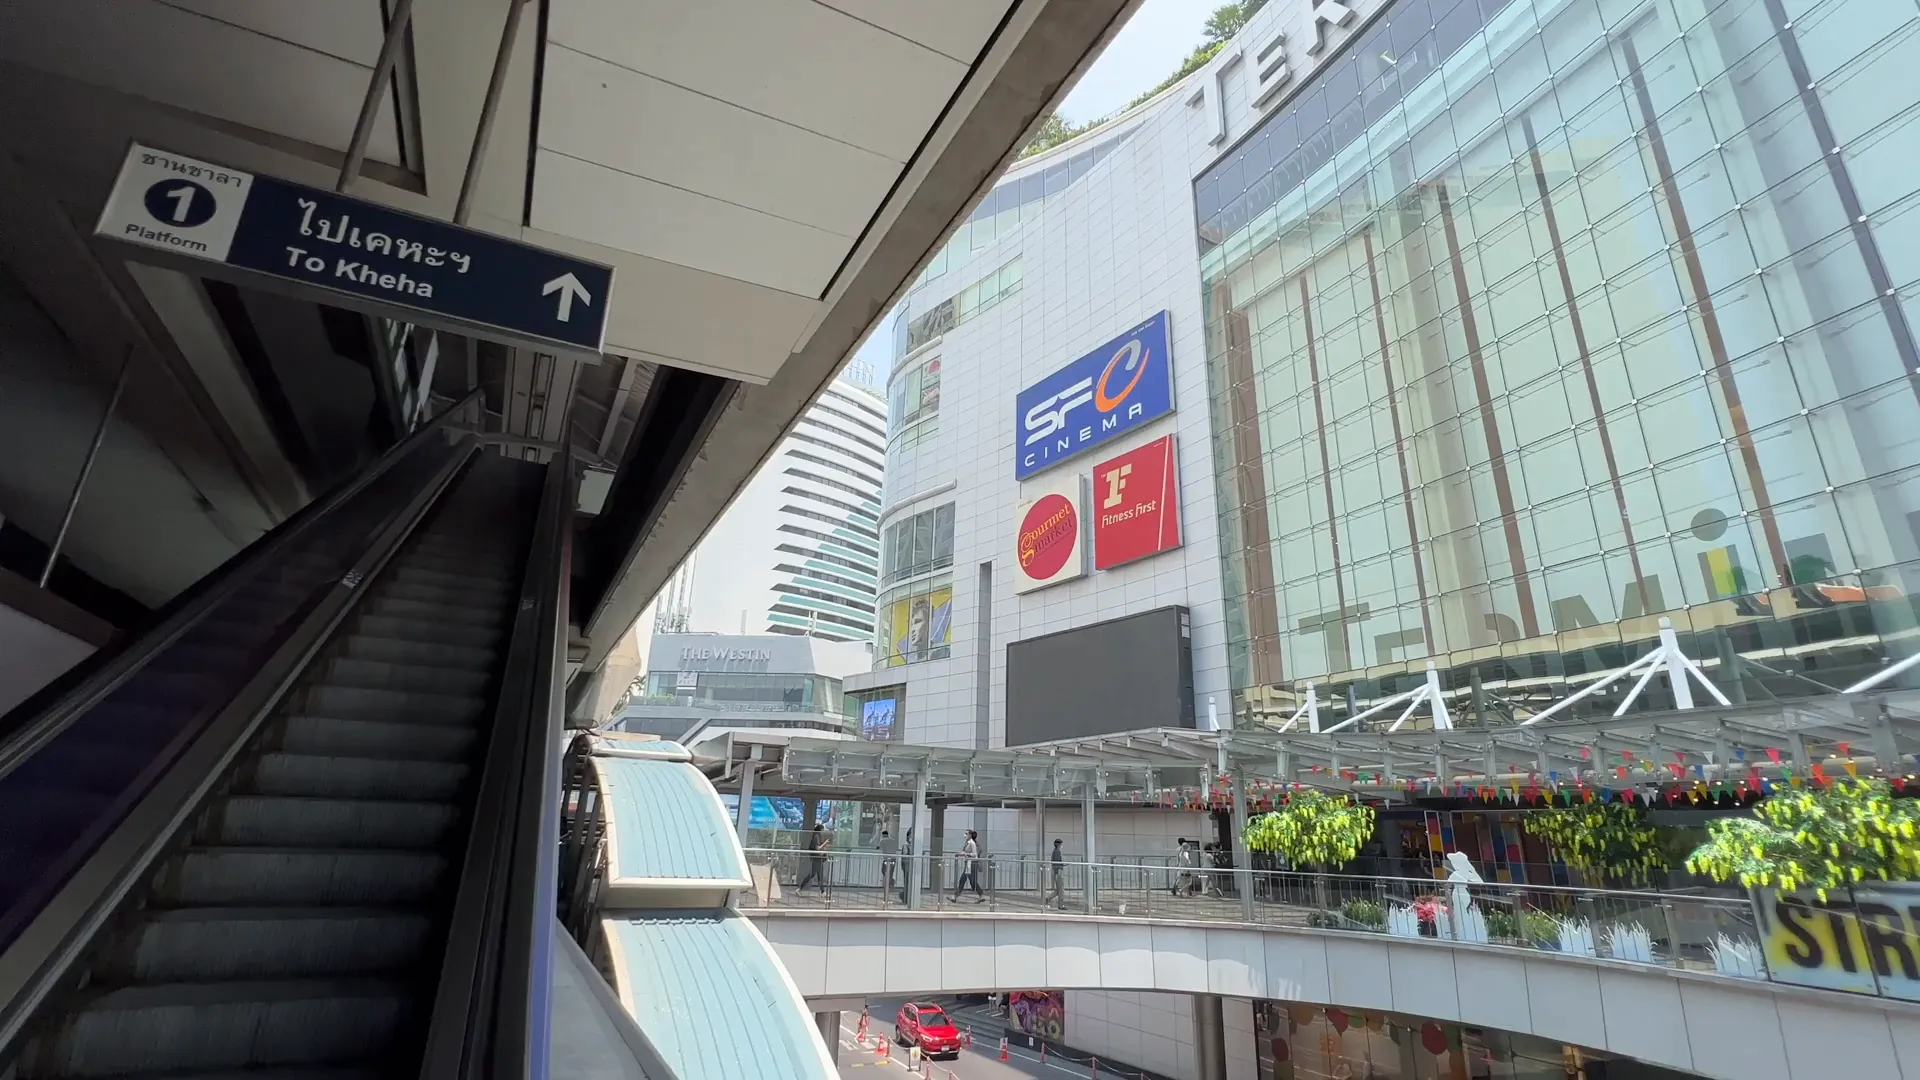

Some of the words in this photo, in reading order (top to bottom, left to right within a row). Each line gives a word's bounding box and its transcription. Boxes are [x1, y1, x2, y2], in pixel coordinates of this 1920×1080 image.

[142, 153, 242, 188] ชานชาลา
[167, 186, 197, 223] 1
[125, 223, 208, 252] Platform
[298, 197, 471, 274] ไปเคหะฯ
[286, 246, 325, 272] To
[335, 258, 433, 298] Kheha
[1024, 402, 1142, 467] CINEMA
[1102, 509, 1134, 529] Fitness
[1135, 500, 1156, 518] First
[682, 647, 710, 661] THE
[713, 646, 772, 661] WESTIN
